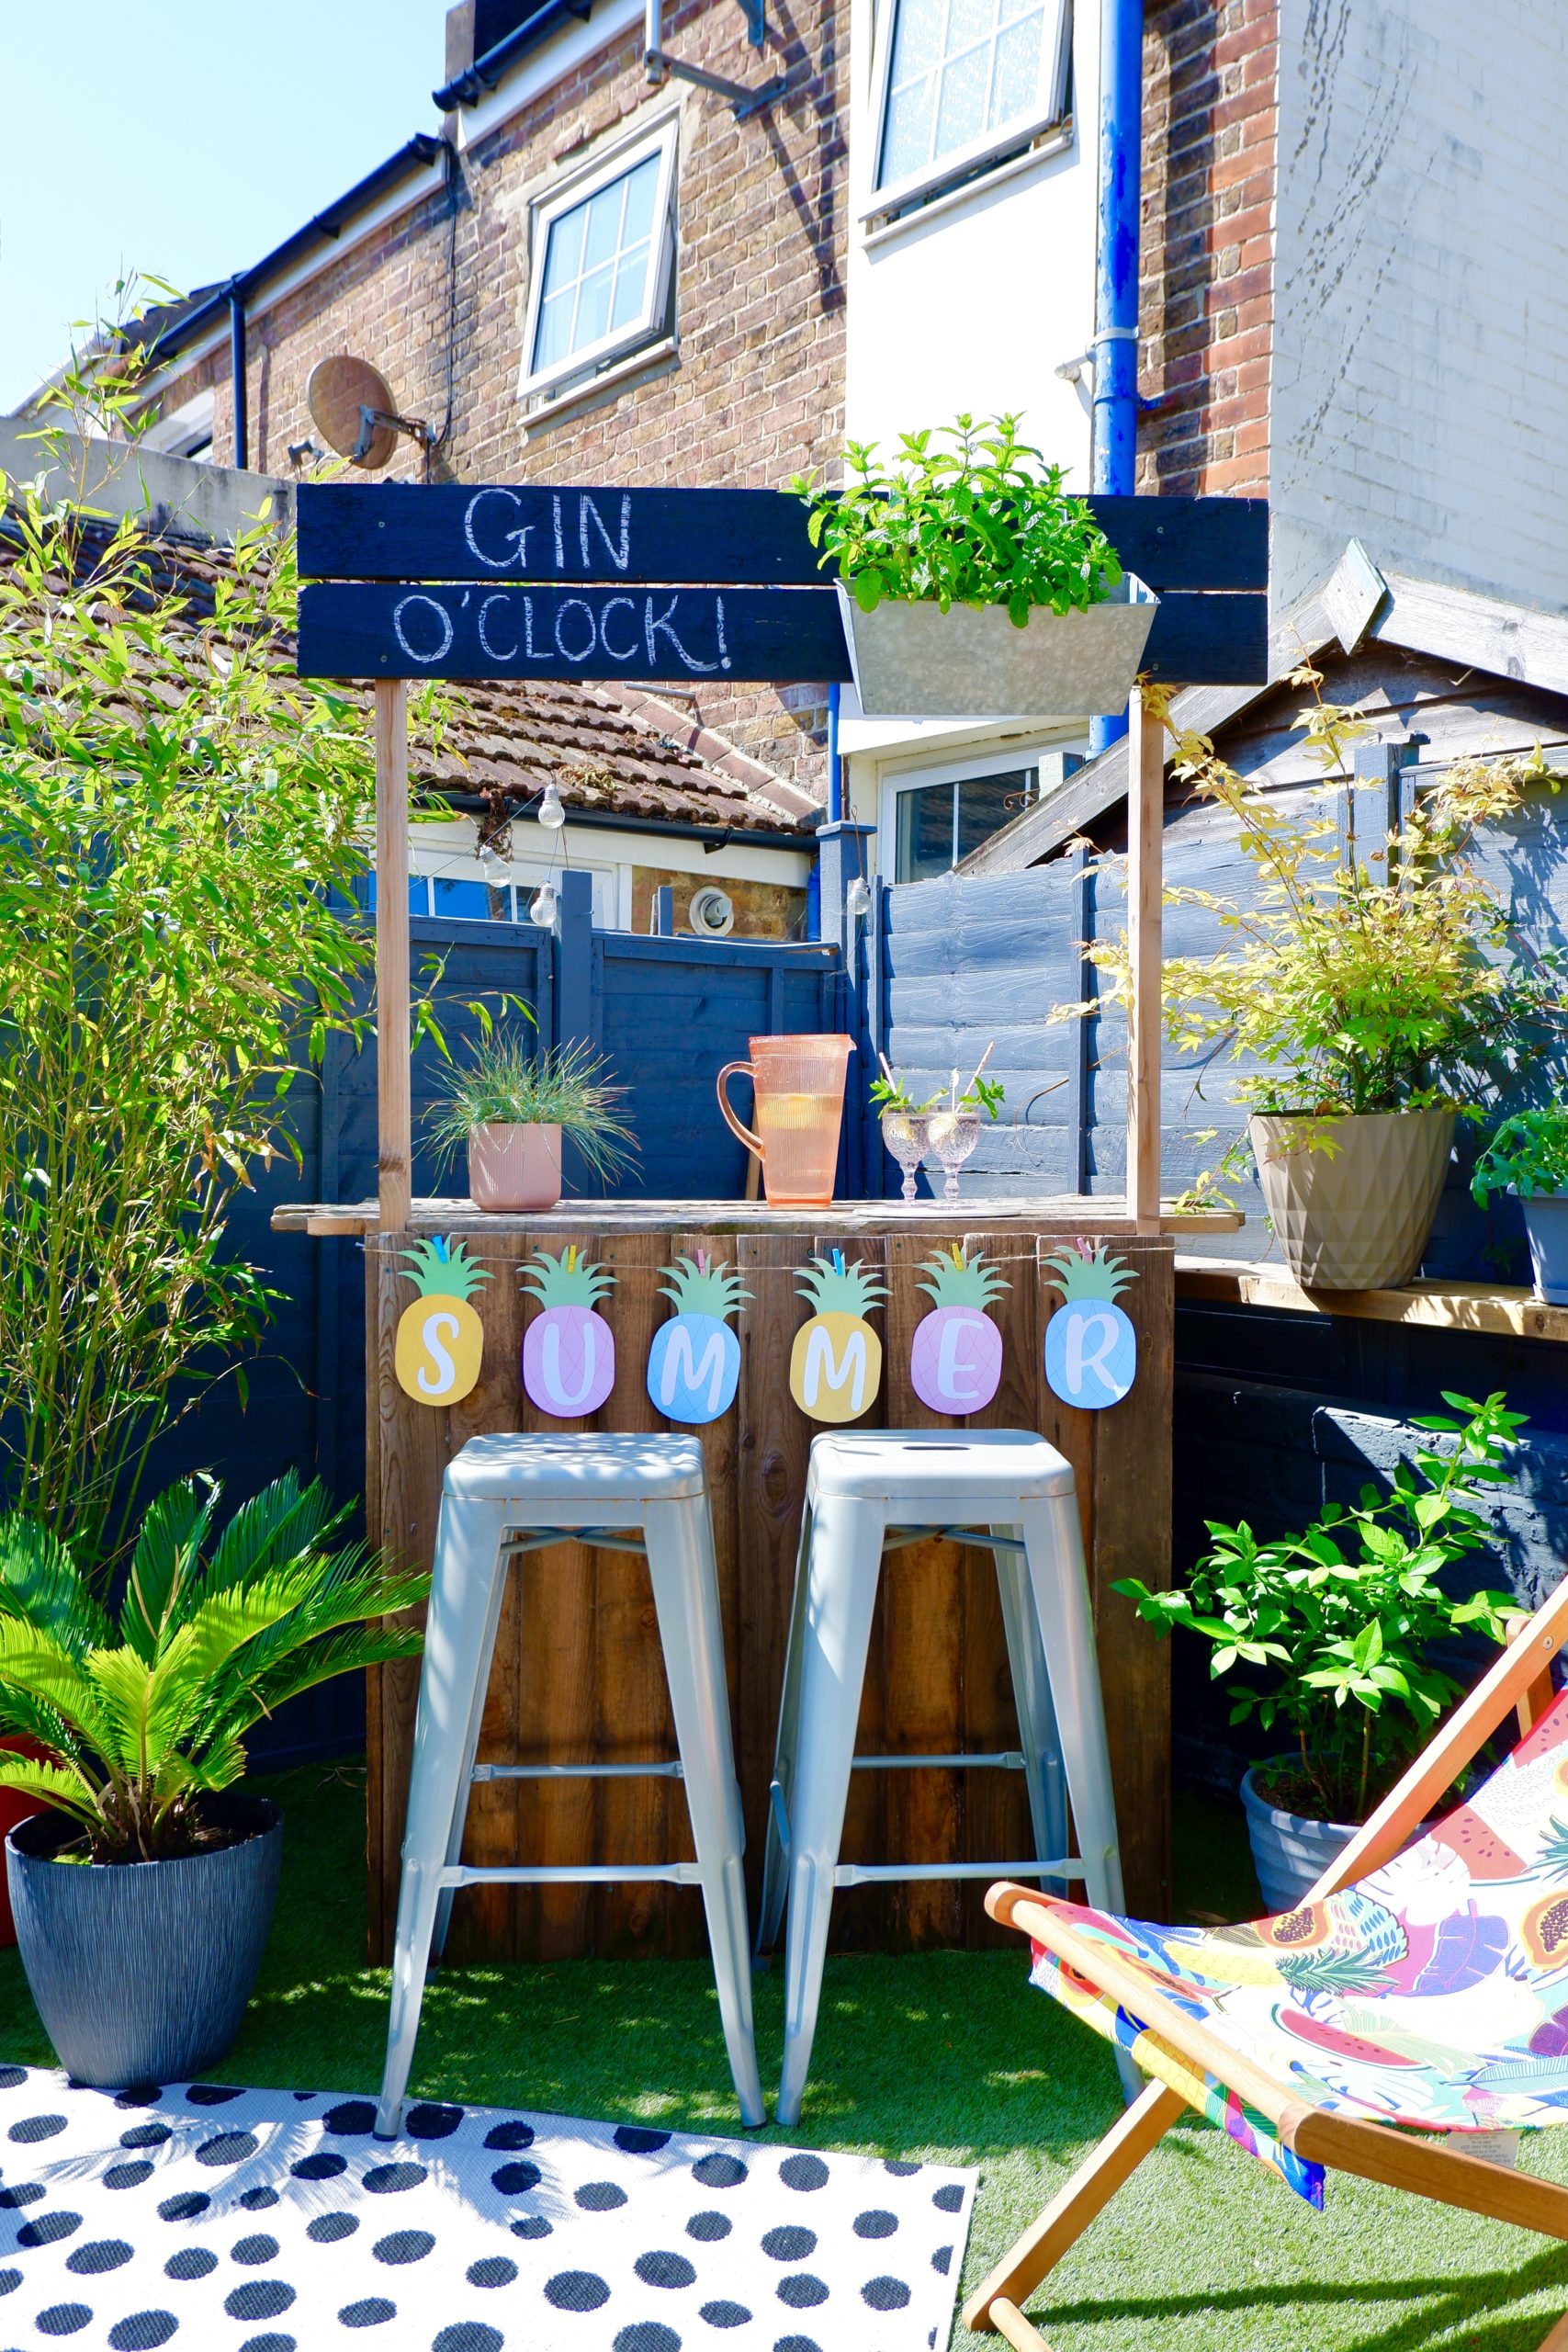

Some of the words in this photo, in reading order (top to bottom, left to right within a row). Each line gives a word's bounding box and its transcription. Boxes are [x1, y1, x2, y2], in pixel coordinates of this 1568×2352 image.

[465, 488, 632, 571] GIN
[393, 591, 732, 672] O'CLOCK!
[417, 1312, 1120, 1413] SUMMER
